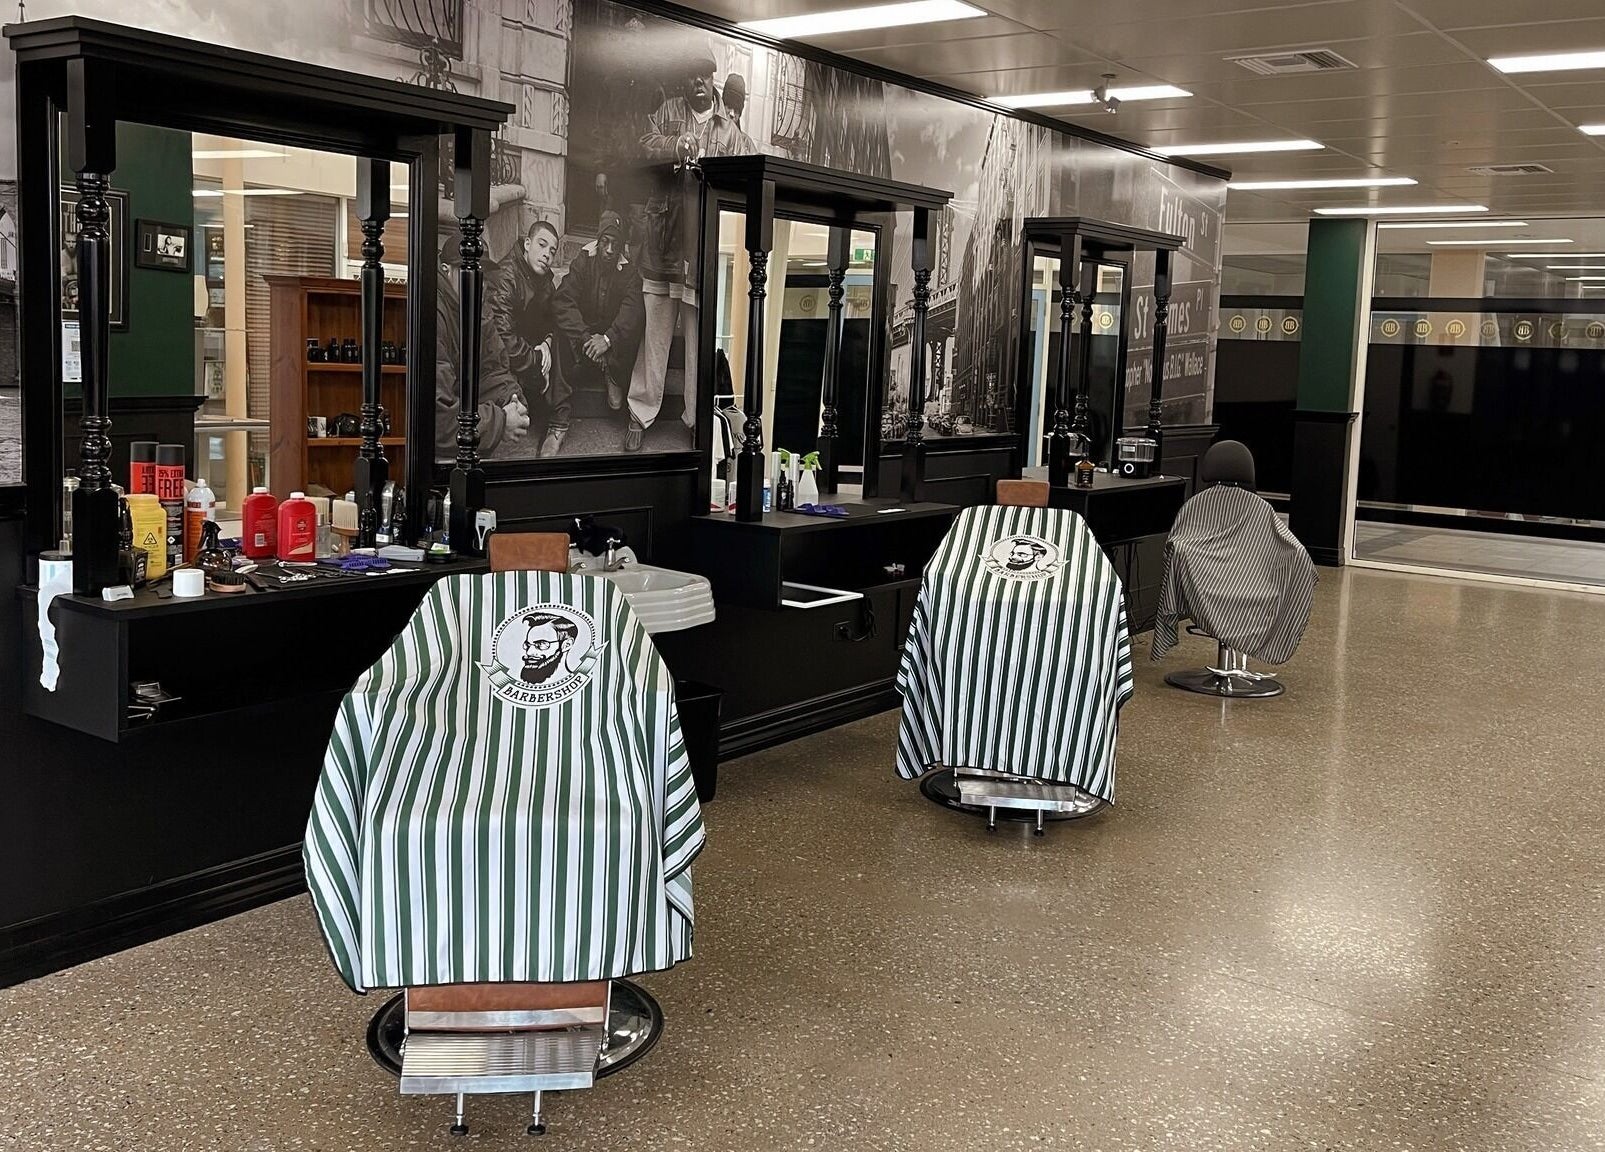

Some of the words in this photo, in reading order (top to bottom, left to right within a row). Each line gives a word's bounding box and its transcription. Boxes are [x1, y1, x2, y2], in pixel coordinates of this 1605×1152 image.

[1158, 184, 1195, 251] Fulton
[1200, 211, 1208, 238] St
[1134, 295, 1149, 339] St
[158, 478, 184, 498] FREE
[503, 675, 583, 703] BARBERSHOP
